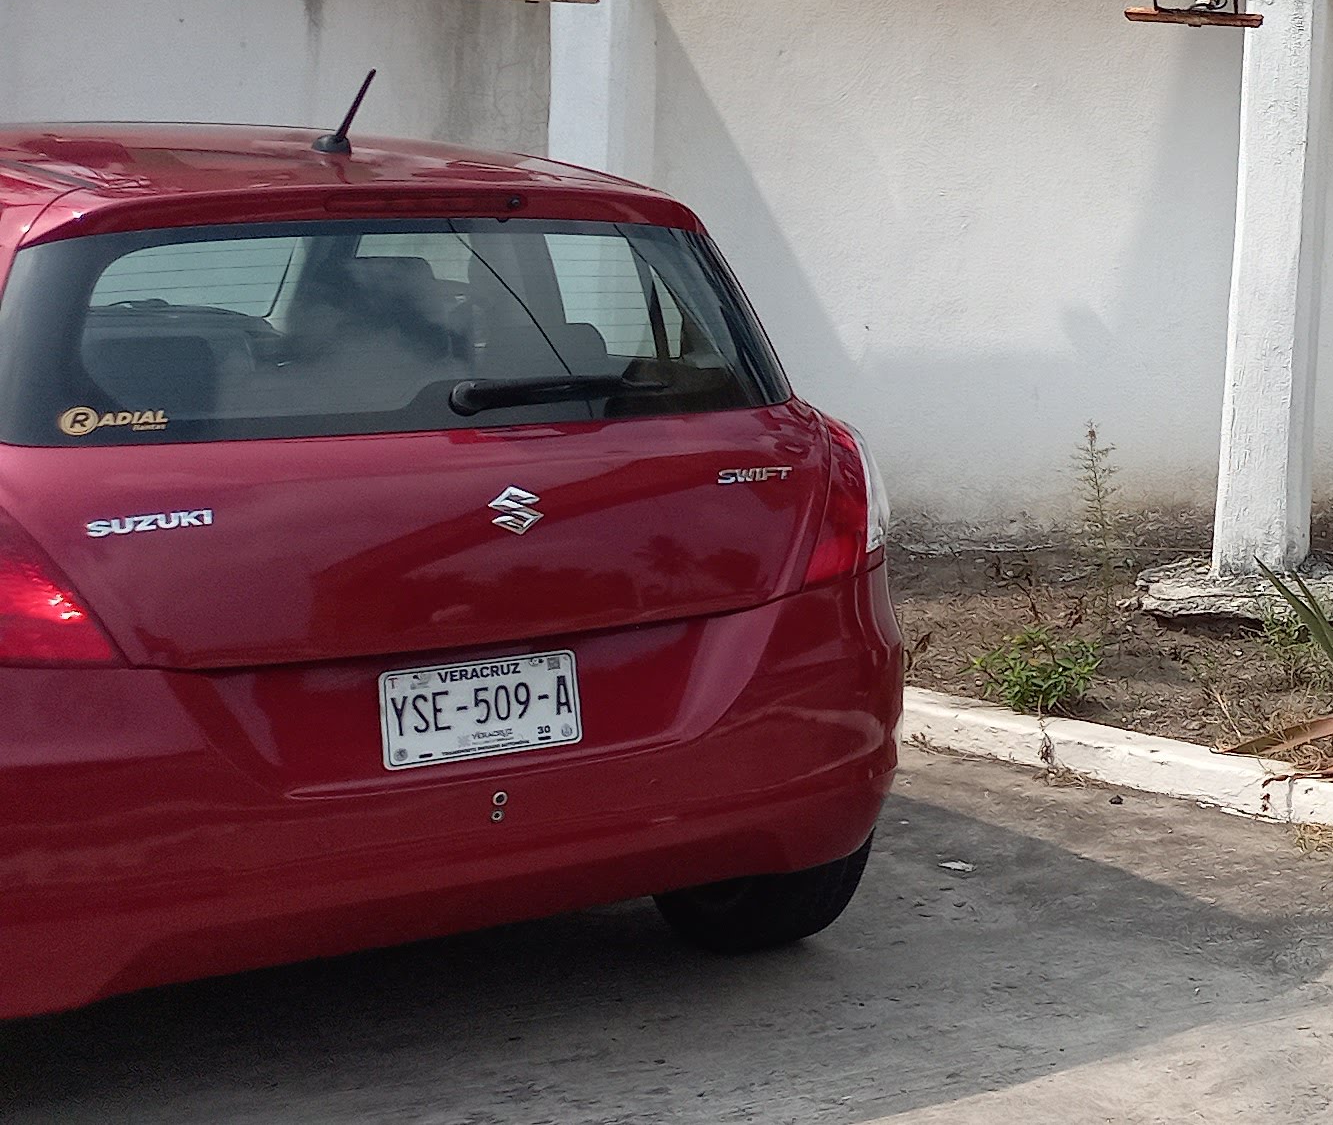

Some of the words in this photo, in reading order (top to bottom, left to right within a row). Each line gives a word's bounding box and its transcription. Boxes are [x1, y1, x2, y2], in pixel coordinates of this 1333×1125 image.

[717, 465, 793, 484] SWIFT
[86, 509, 213, 537] SUZUKI
[438, 663, 521, 683] VERACRUZ
[390, 675, 573, 736] YSE-509-A
[537, 725, 551, 735] 30
